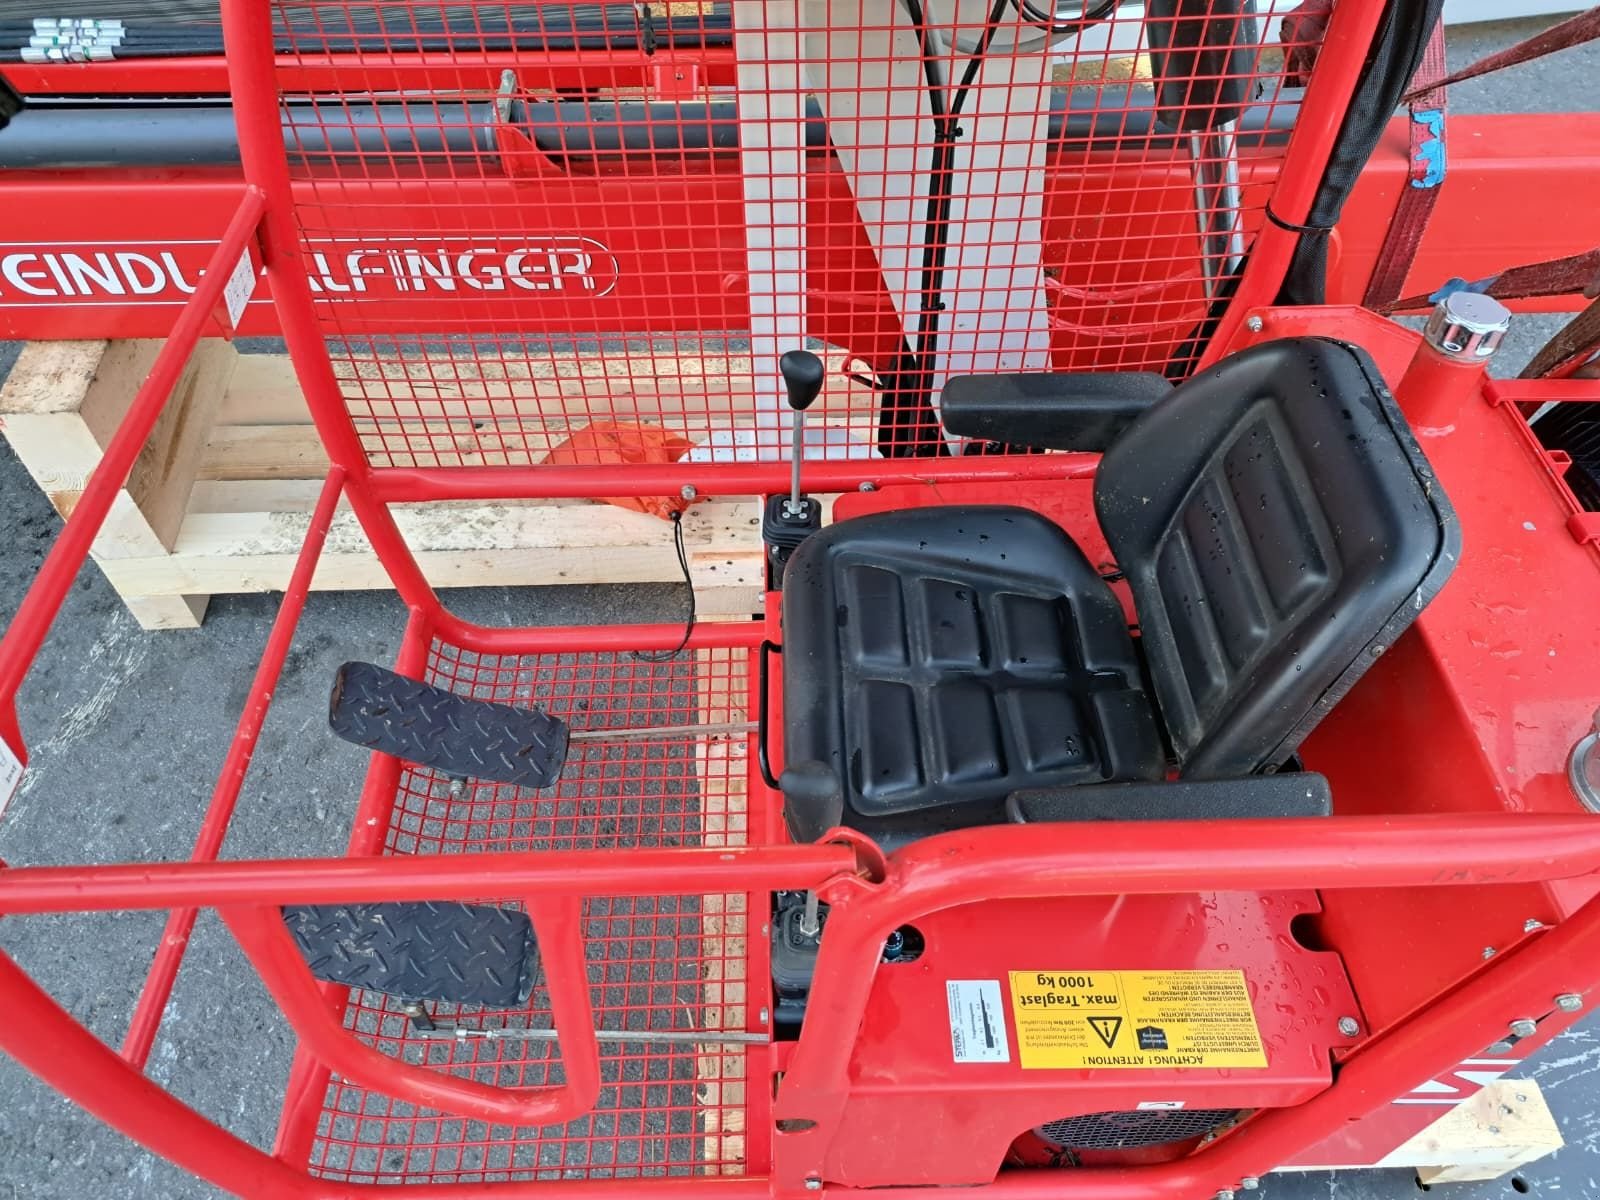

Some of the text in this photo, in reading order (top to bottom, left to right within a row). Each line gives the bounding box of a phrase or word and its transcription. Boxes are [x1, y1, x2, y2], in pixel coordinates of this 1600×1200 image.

[1037, 974, 1094, 988] 1000 kg
[1020, 992, 1117, 1007] max. Traglast
[1088, 1056, 1144, 1064] ATTENTION
[1154, 1056, 1203, 1064] ACHTUNG
